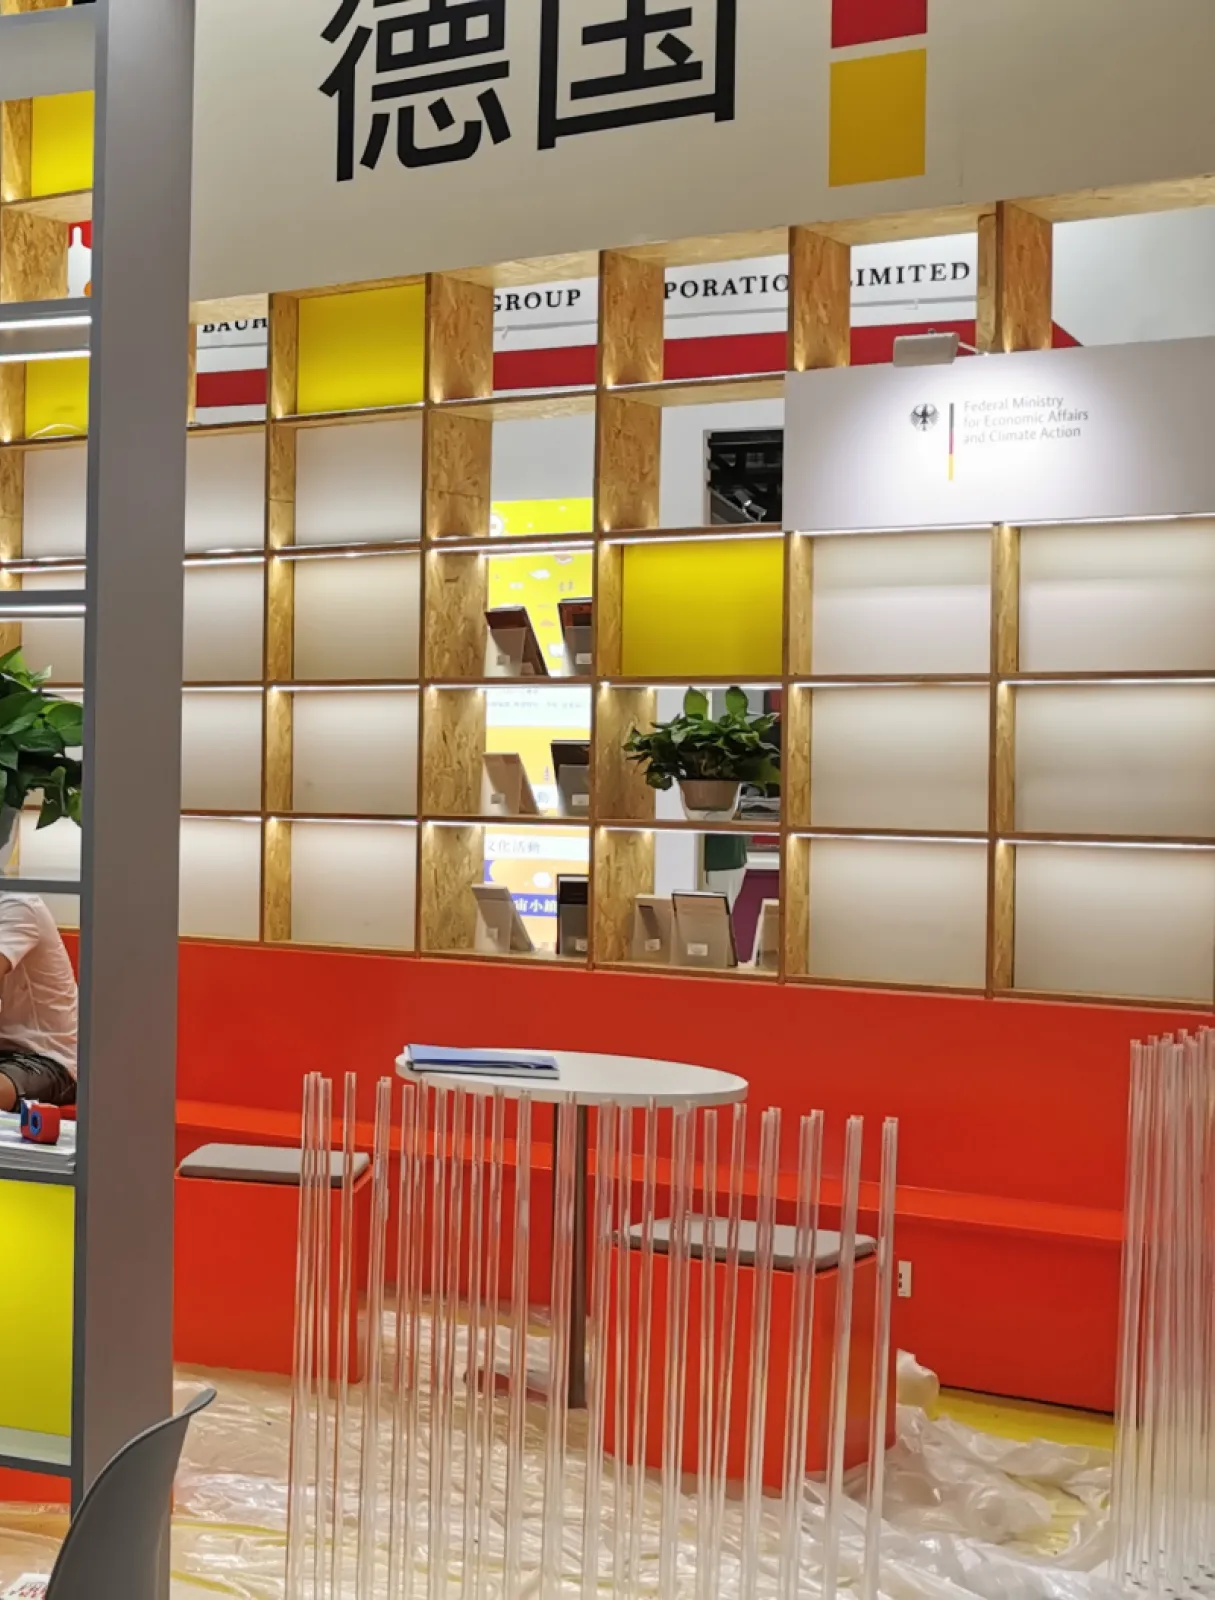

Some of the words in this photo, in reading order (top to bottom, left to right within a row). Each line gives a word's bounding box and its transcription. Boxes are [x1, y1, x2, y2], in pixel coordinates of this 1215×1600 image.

[320, 0, 736, 181] 德国
[493, 288, 581, 312] GROUP
[849, 261, 970, 288] IMITED
[964, 400, 1008, 414] Federal
[1013, 396, 1064, 410] Ministry
[964, 415, 980, 428] for
[984, 413, 1044, 428] Economic
[1047, 409, 1089, 424] Affairs
[964, 431, 985, 443] and
[989, 427, 1037, 443] Climate
[1040, 424, 1082, 440] Action
